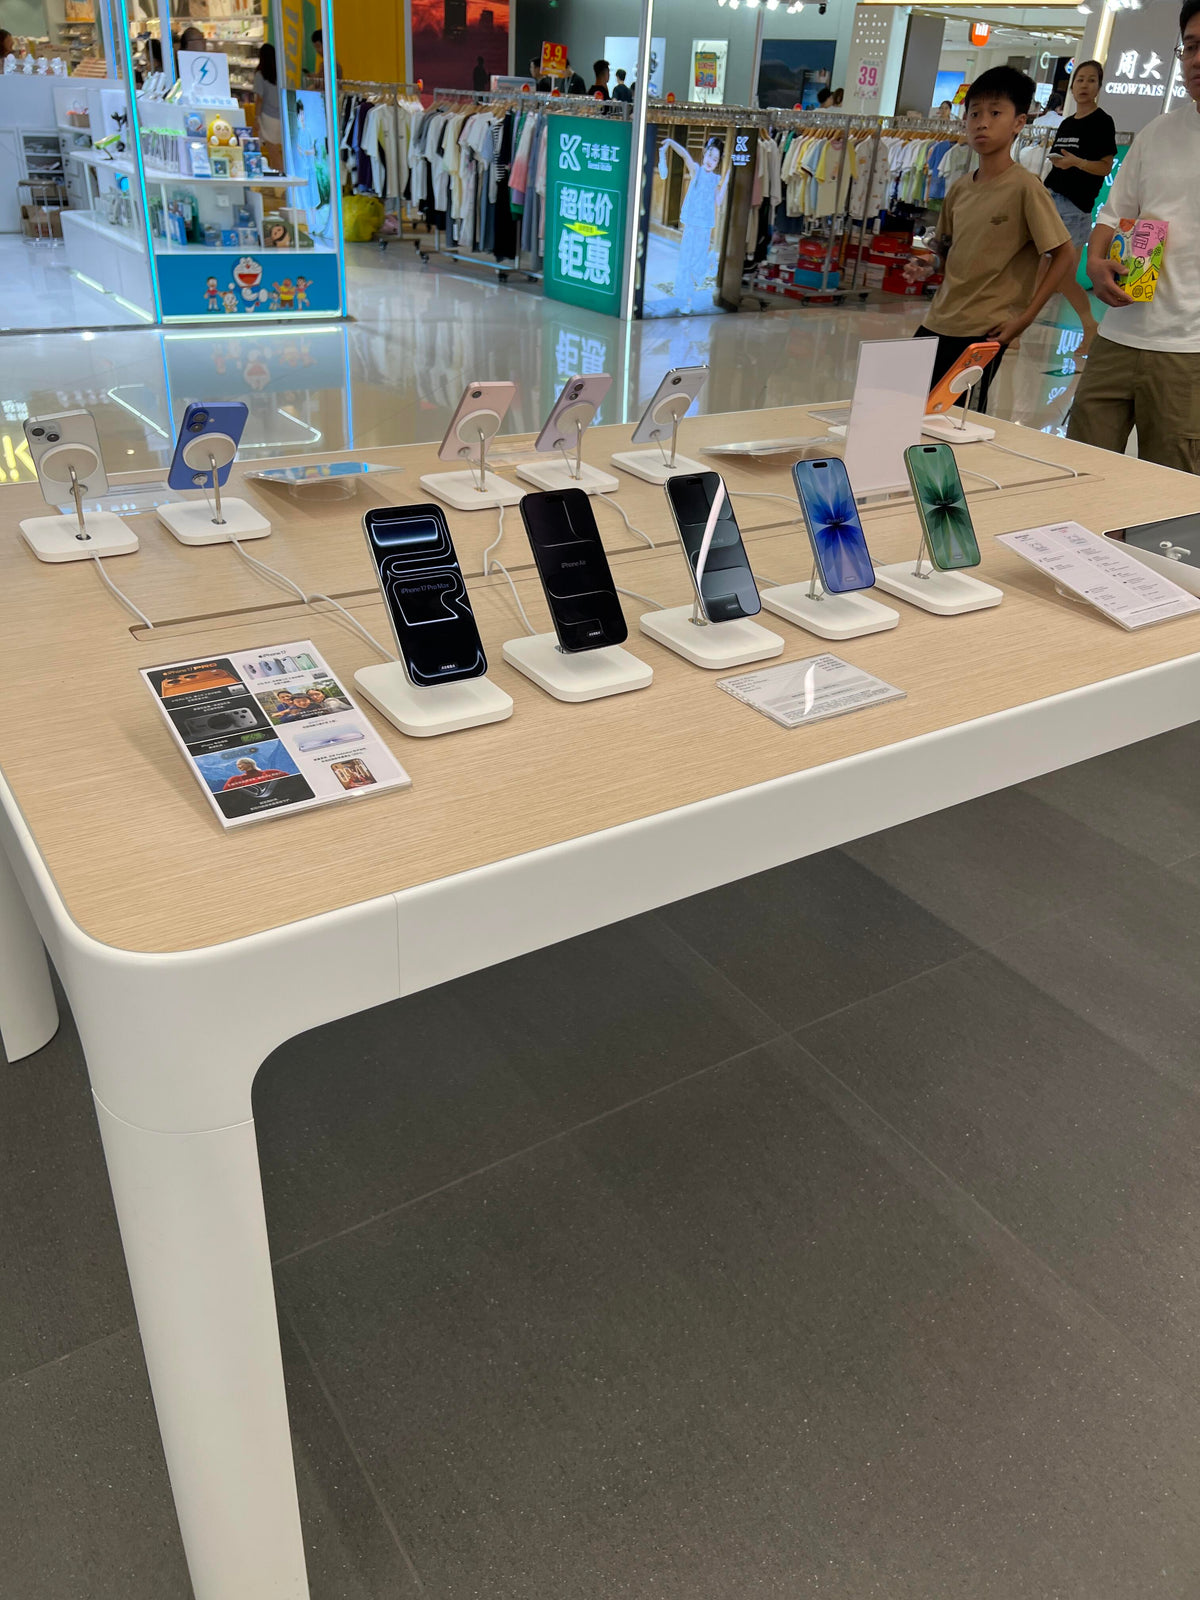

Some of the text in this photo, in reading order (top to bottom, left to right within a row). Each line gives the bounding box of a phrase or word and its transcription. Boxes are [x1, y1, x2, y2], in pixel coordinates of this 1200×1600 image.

[1105, 82, 1187, 98] CHOWTAISNG
[559, 186, 613, 227] 超低价
[558, 228, 612, 285] 钜惠
